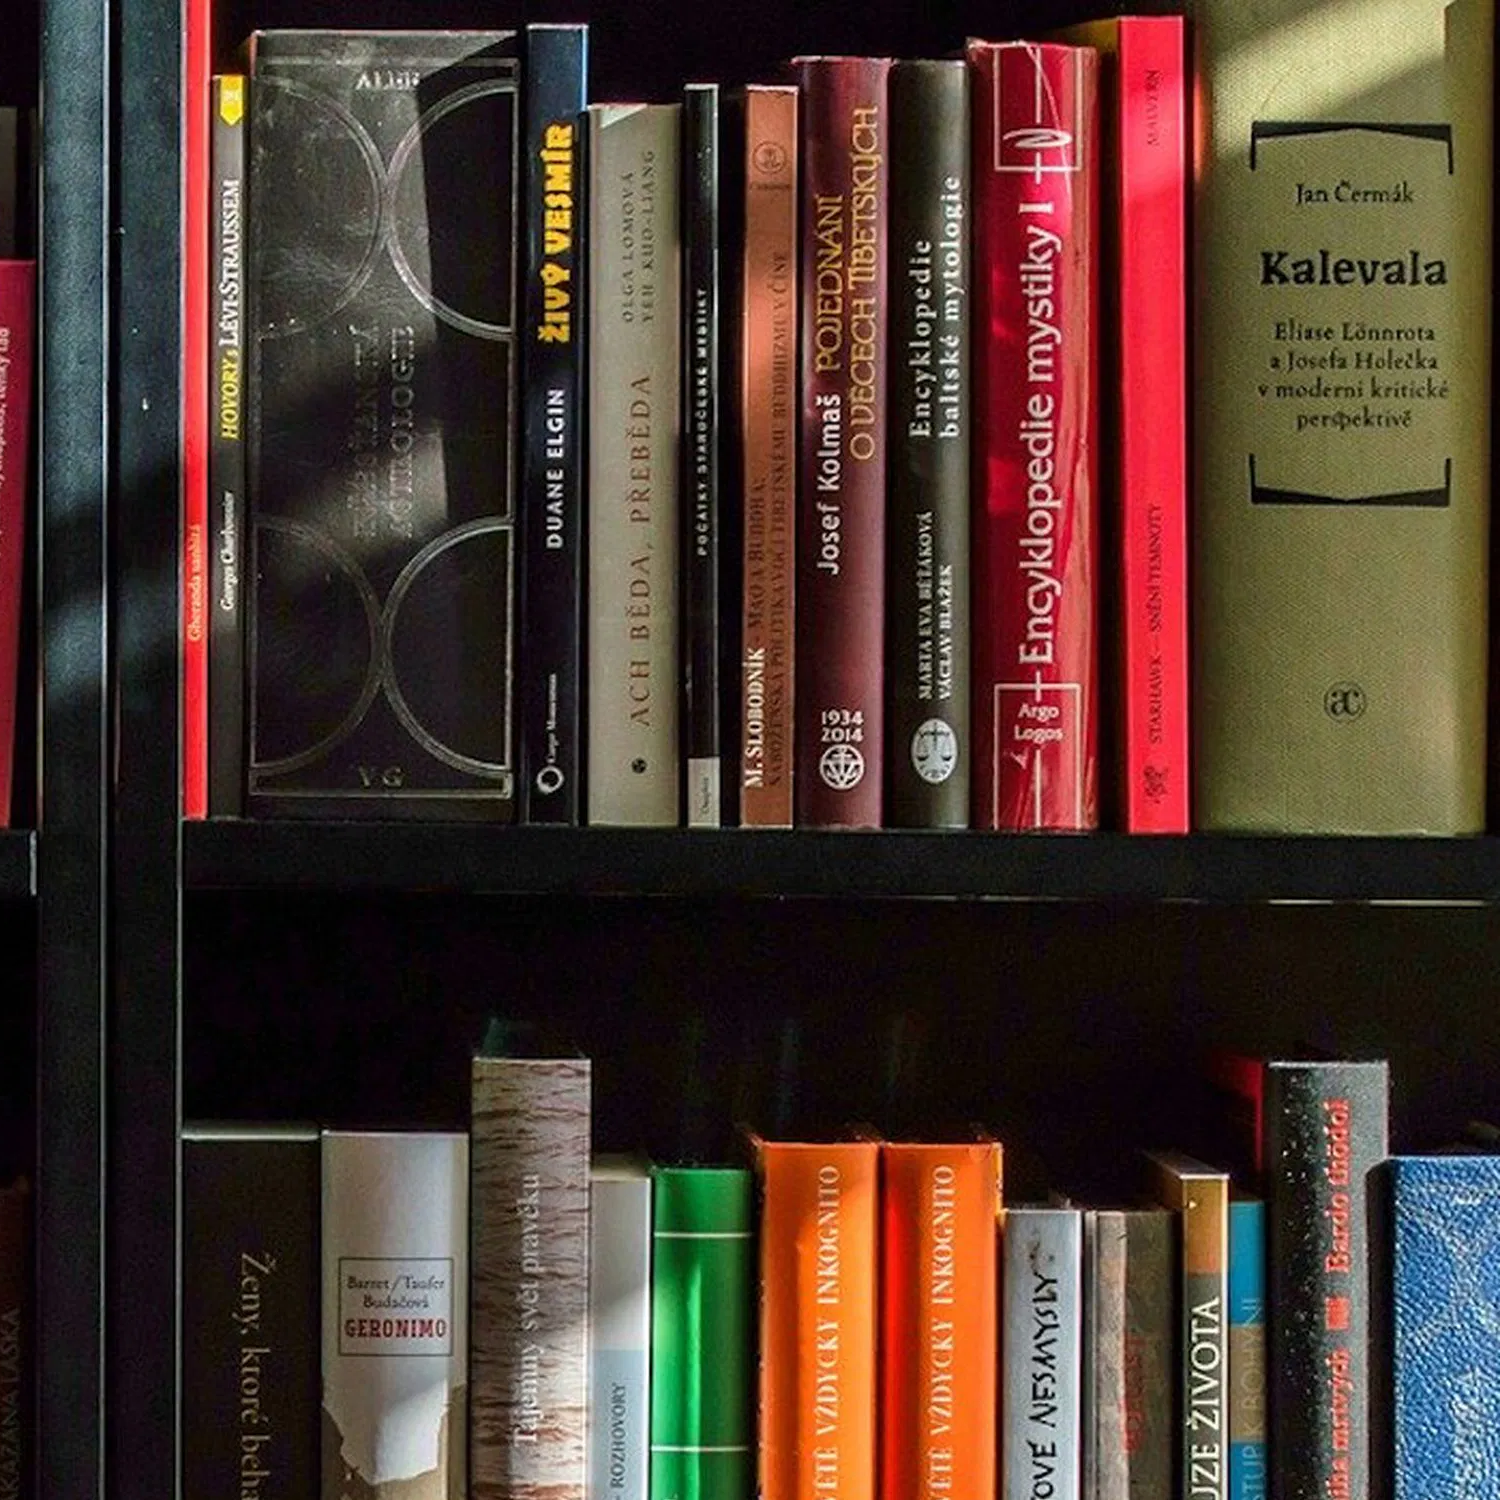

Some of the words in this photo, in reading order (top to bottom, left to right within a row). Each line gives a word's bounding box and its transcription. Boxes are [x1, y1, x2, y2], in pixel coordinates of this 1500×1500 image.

[540, 126, 573, 253] VESMÍR
[1019, 201, 1052, 214] I
[1295, 183, 1328, 206] Jan
[1335, 179, 1414, 205] Čermák
[939, 177, 965, 322] mytologie
[1260, 251, 1447, 287] Kalevala
[911, 240, 937, 438] Encyklopedie
[1020, 226, 1064, 382] mystiky
[1275, 322, 1335, 342] Eliase
[1342, 321, 1435, 342] Lönnrota
[221, 361, 239, 440] HOVORY
[937, 335, 961, 438] baltské
[1259, 384, 1268, 398] v
[1370, 377, 1448, 399] kritické
[1270, 356, 1281, 369] a
[1287, 350, 1348, 374] Josefa
[1355, 349, 1437, 371] Holečka
[547, 389, 565, 458] ELGIN
[816, 394, 843, 490] Kolmaš
[1296, 406, 1412, 432] perspektivě
[545, 469, 565, 549] DUANE
[816, 505, 843, 575] Josef
[1019, 394, 1065, 663] Encyklopedie
[816, 1166, 840, 1304] INKOGNITO
[239, 1252, 275, 1336] Ženy,
[345, 1319, 447, 1339] GERONIMO
[239, 1346, 271, 1421] ktoré
[813, 1319, 840, 1435] VŽDYCKY
[1184, 1297, 1220, 1430] ŽIVOTA
[611, 1382, 627, 1489] ROZHOVORY
